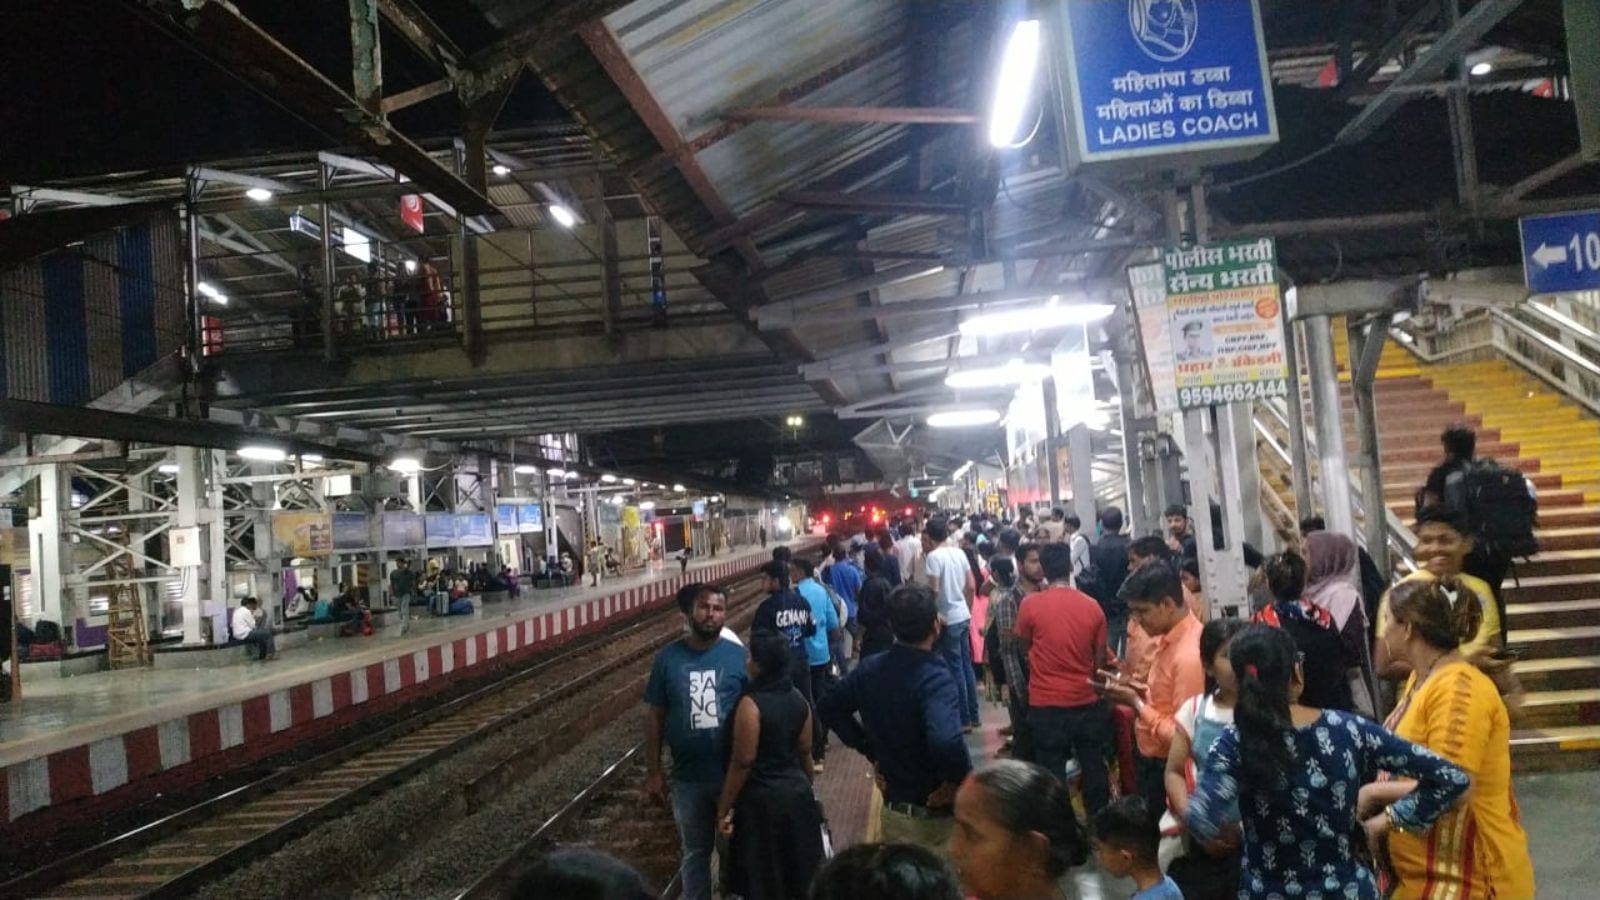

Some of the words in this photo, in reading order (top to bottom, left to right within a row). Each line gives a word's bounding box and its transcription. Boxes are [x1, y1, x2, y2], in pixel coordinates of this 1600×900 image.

[1112, 69, 1186, 93] महिलांचा
[1191, 66, 1231, 86] डब्बा
[1096, 93, 1174, 120] महिलाओं
[1179, 94, 1203, 111] का
[1208, 88, 1254, 110] डिब्बा
[1099, 120, 1176, 145] LADIES
[1182, 112, 1259, 136] COACH
[1165, 245, 1224, 270] पोलीस
[1228, 238, 1273, 263] भरती
[1569, 233, 1600, 272] 10
[1220, 262, 1274, 288] भरती
[1181, 379, 1288, 407] 9594662444
